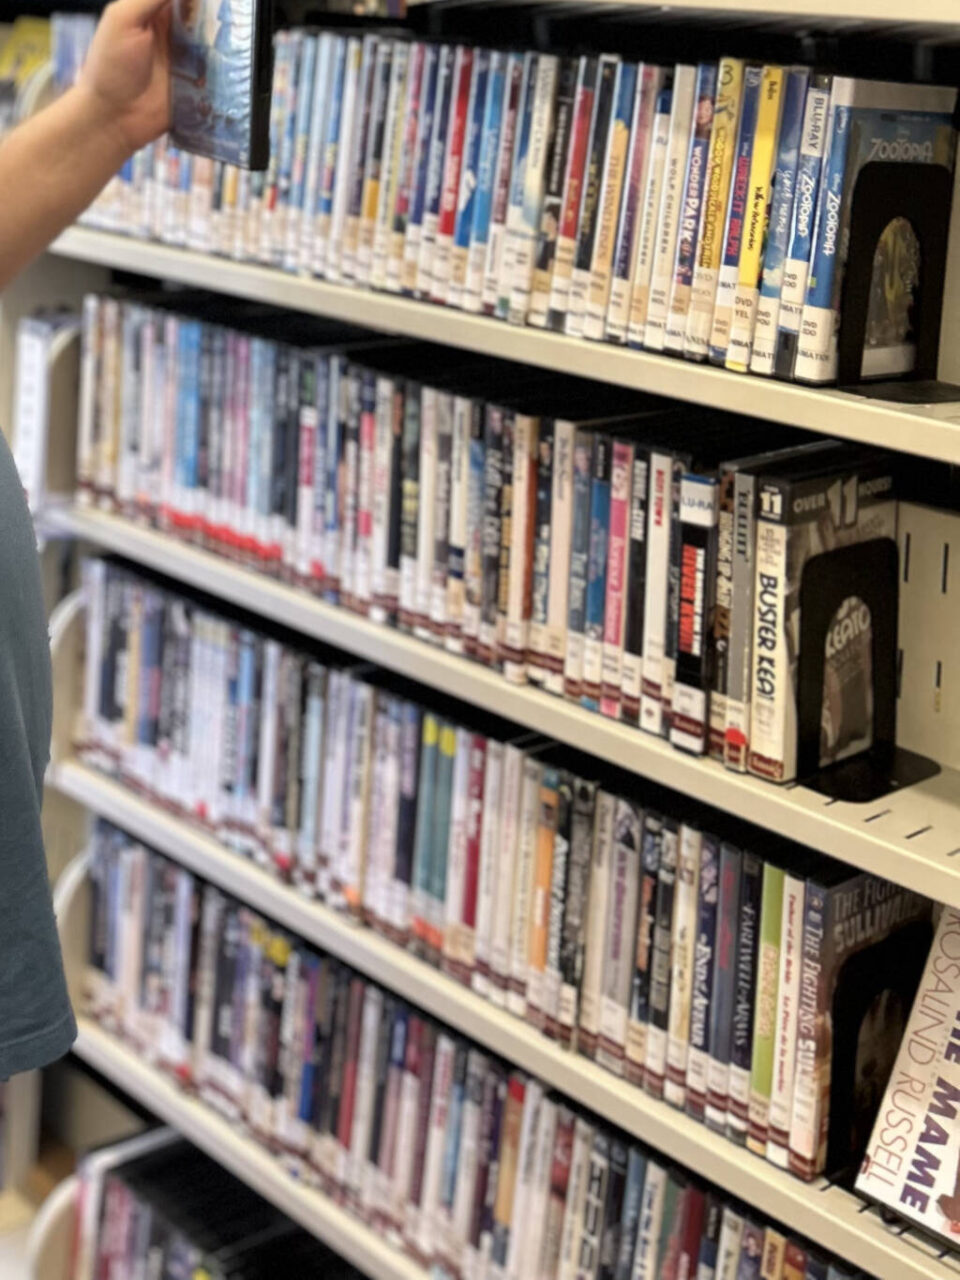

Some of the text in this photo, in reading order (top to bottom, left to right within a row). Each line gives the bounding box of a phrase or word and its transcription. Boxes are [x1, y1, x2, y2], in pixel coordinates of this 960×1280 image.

[808, 97, 825, 150] BLU-RAY
[869, 138, 933, 160] ZOOTOPIA
[660, 158, 678, 255] WOLF CHILDREN
[681, 146, 703, 243] WONDER PARK
[732, 156, 749, 213] WRECK-IT
[798, 173, 816, 238] ZOOTOPIA
[727, 217, 744, 256] RALPH
[823, 191, 841, 256] ZOOTOPIA
[735, 296, 753, 307] DVD
[735, 309, 749, 319] YEL
[654, 496, 665, 527] TOWN
[760, 492, 783, 516] 11
[793, 493, 826, 513] OVER
[827, 475, 859, 528] 11
[681, 544, 697, 602] RIVER
[697, 548, 706, 570] THE
[757, 573, 779, 651] BUSTER
[825, 603, 871, 659] KEATO
[756, 657, 777, 702] KEA
[805, 925, 824, 958] THE
[691, 943, 712, 1047] END AFFAIR
[733, 907, 756, 1046] FAREWELL ARMS
[800, 958, 822, 1036] FIGHTING
[865, 1071, 927, 1187] RUSSELL
[898, 1076, 960, 1214] MAME
